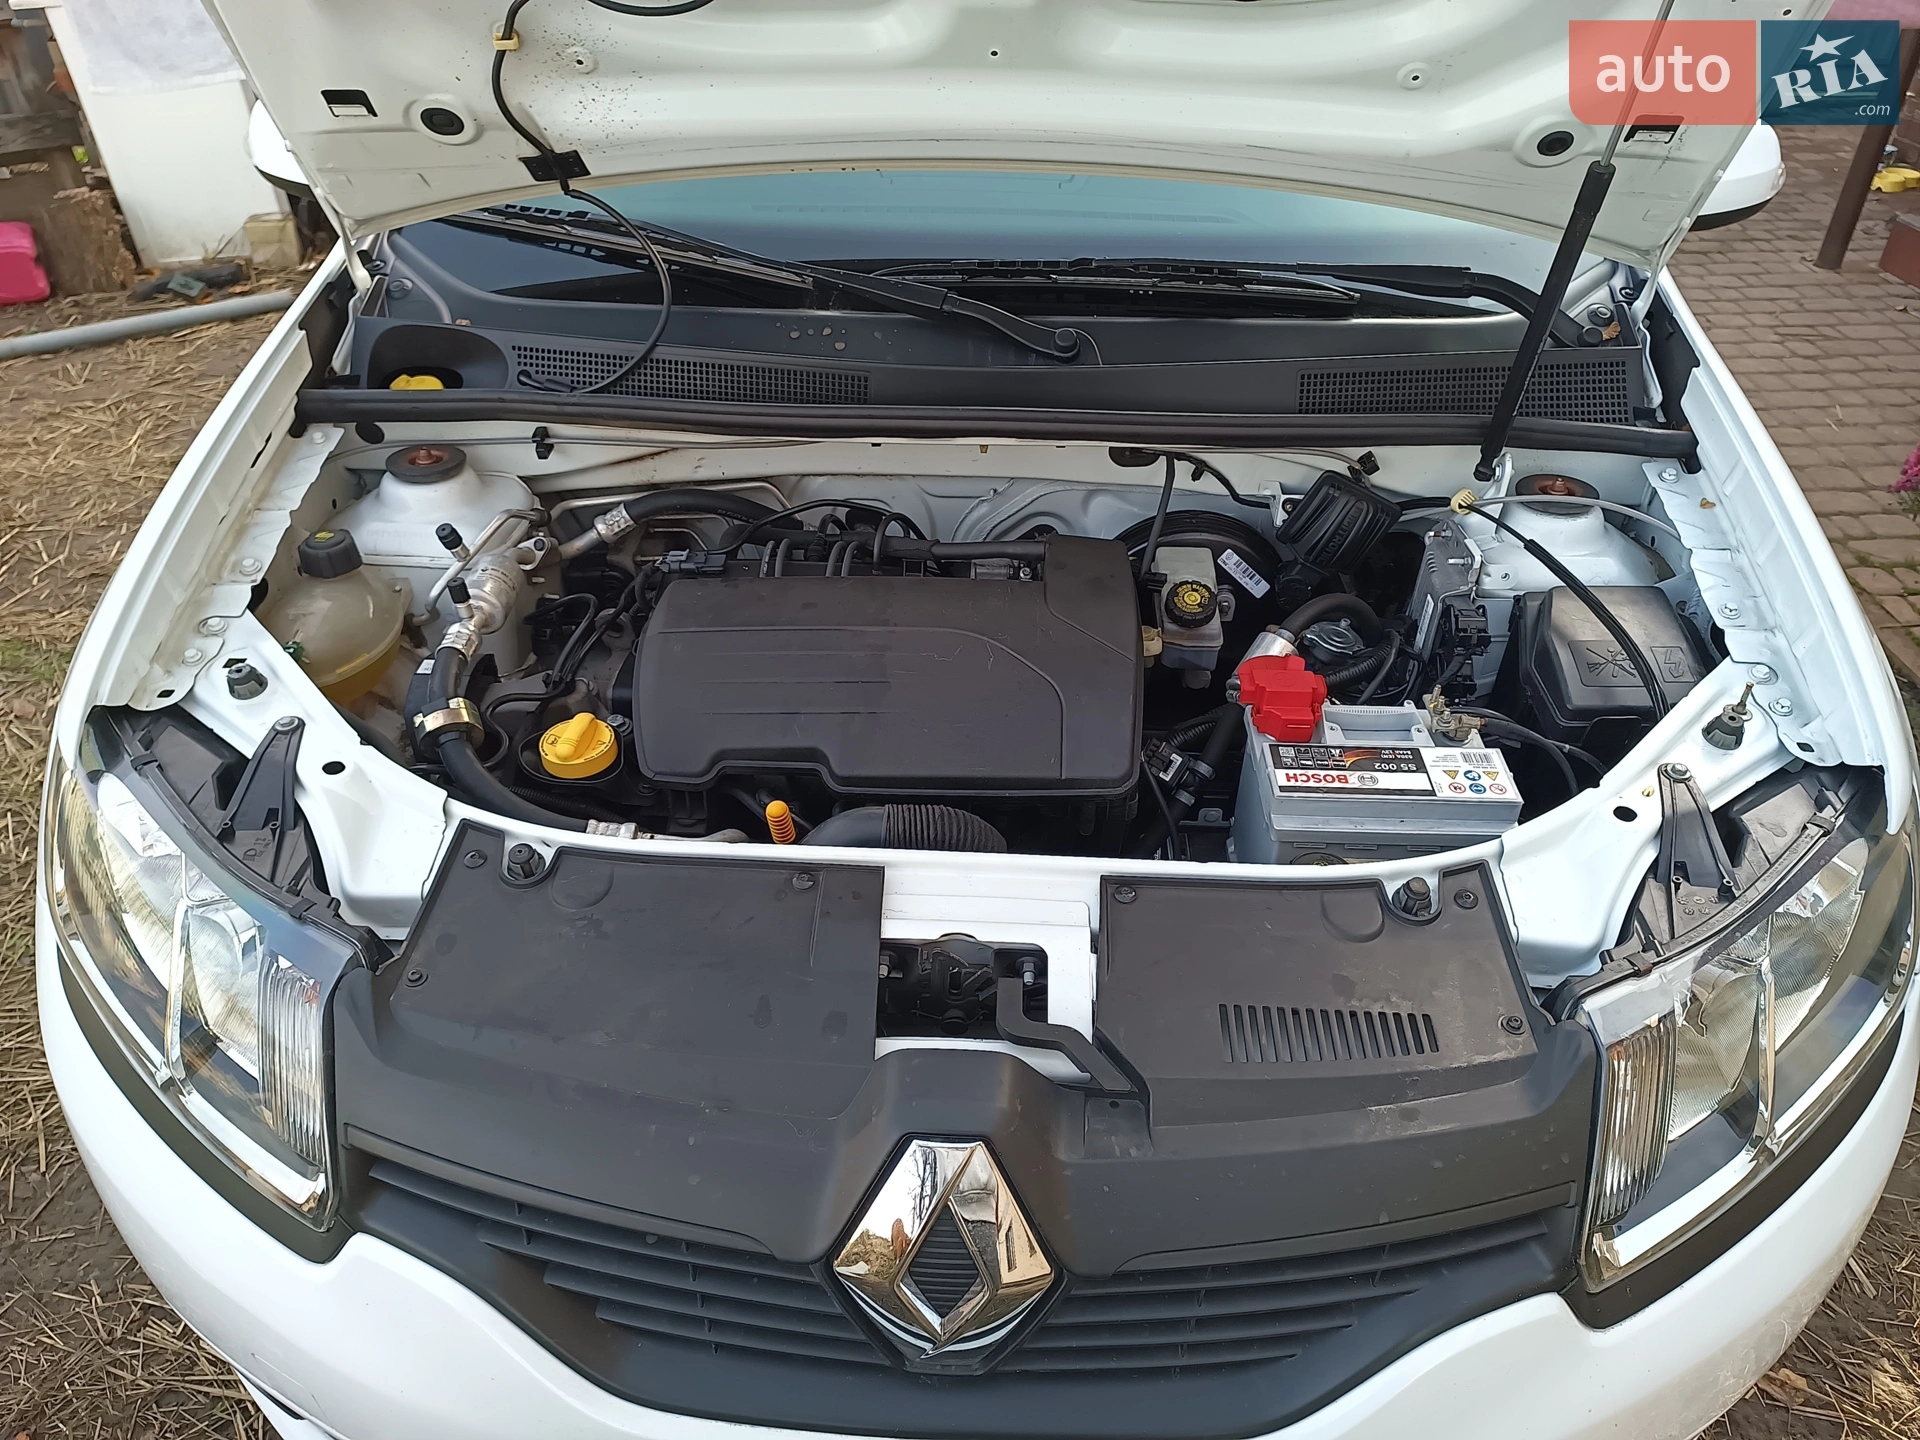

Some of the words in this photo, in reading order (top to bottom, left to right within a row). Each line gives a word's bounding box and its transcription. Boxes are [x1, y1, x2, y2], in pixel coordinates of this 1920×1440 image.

[1373, 761, 1397, 771] 002
[1400, 762, 1417, 771] S5
[1285, 772, 1349, 784] BOSCH
